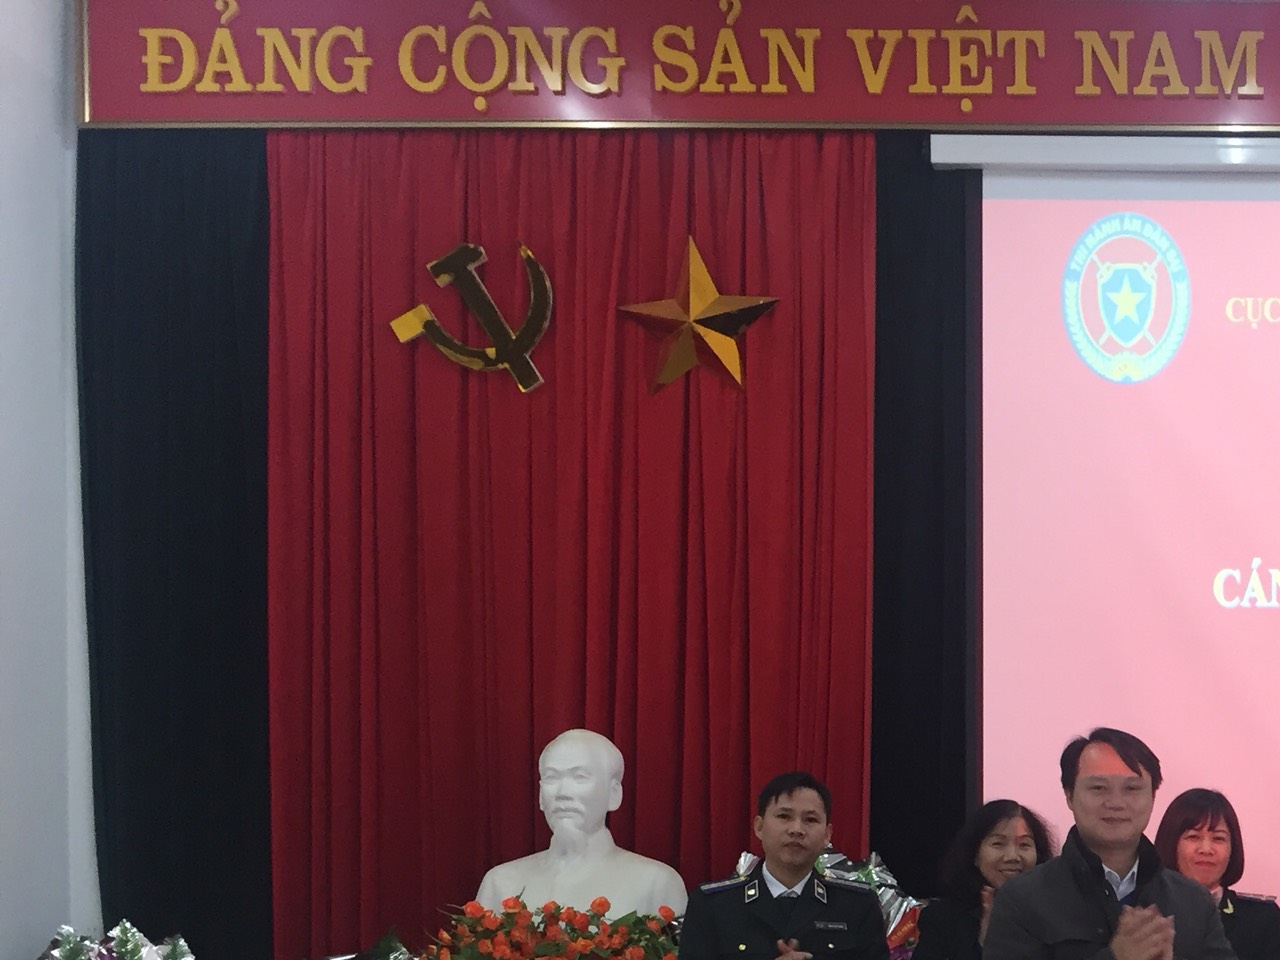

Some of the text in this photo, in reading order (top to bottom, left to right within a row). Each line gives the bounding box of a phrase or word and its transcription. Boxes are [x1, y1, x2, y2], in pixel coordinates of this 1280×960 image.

[139, 0, 373, 94] ĐẢNG
[398, 0, 626, 112] CỘNG
[653, 0, 821, 95] SẢN
[846, 5, 1045, 112] VIỆT
[1074, 31, 1264, 97] NAM
